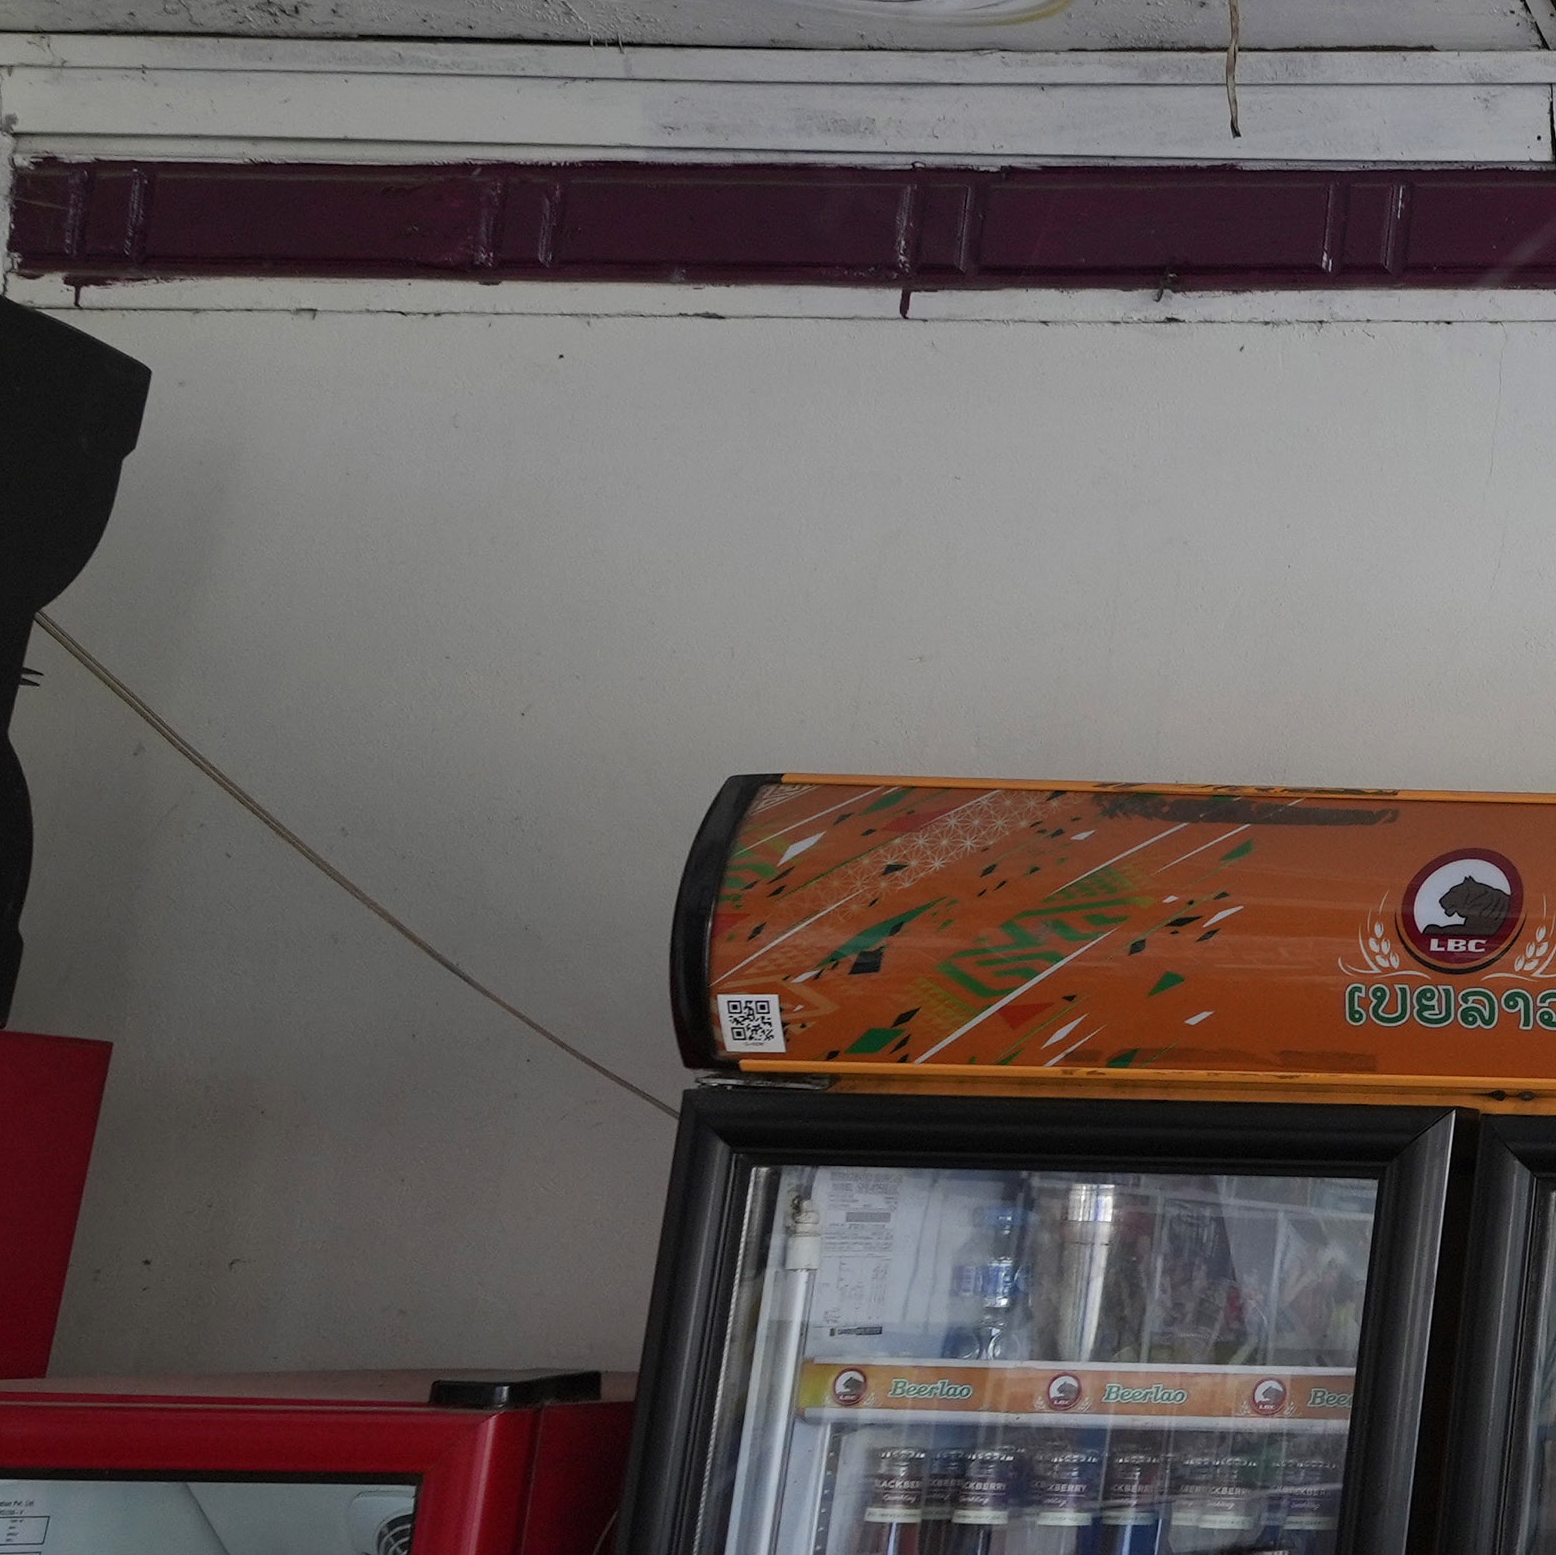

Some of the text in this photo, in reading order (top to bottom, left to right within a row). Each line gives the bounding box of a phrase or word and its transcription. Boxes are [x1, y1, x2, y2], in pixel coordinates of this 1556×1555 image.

[1429, 937, 1488, 954] LBC
[888, 1378, 974, 1401] Beerlao
[1102, 1383, 1189, 1407] Beerlao
